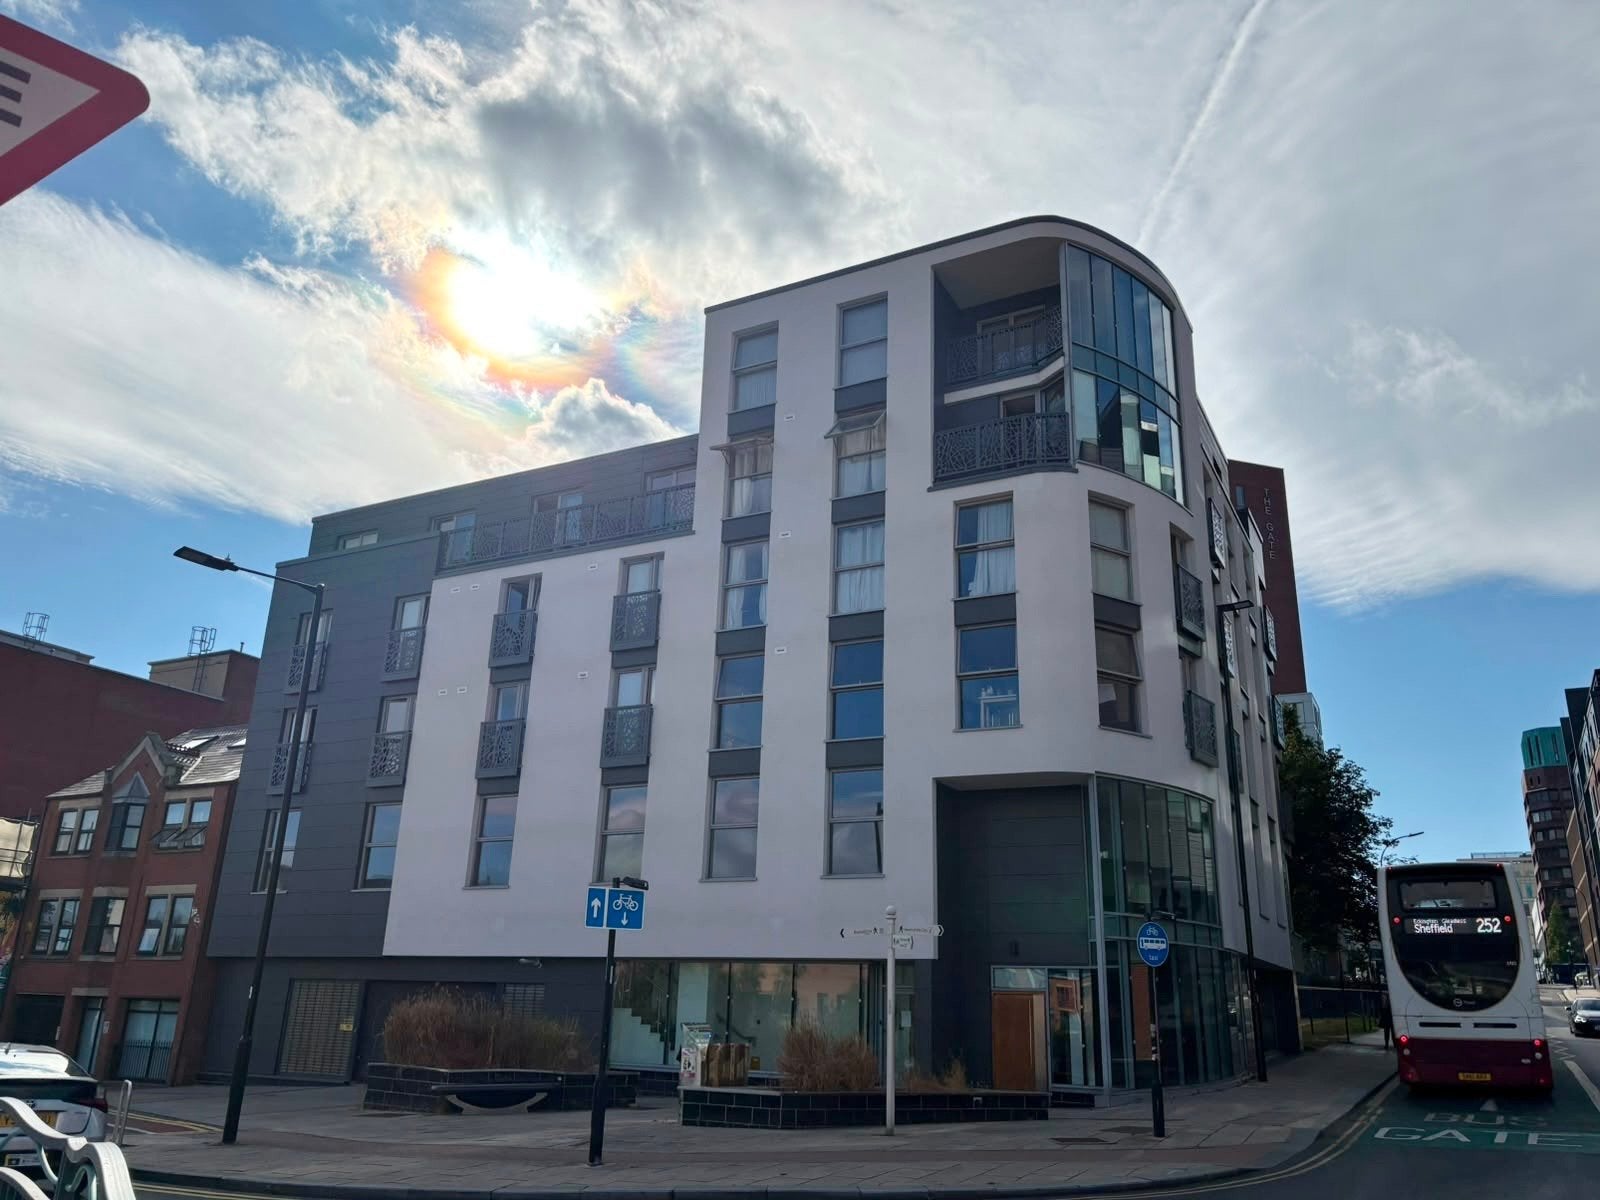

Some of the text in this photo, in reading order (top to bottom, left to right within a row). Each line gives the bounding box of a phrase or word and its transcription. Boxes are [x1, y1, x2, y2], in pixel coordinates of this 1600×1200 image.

[1266, 522, 1275, 559] GATE
[1414, 923, 1453, 933] Sheffield
[1476, 917, 1502, 933] 252
[1424, 1112, 1548, 1126] BUS
[1374, 1126, 1584, 1148] GATE
